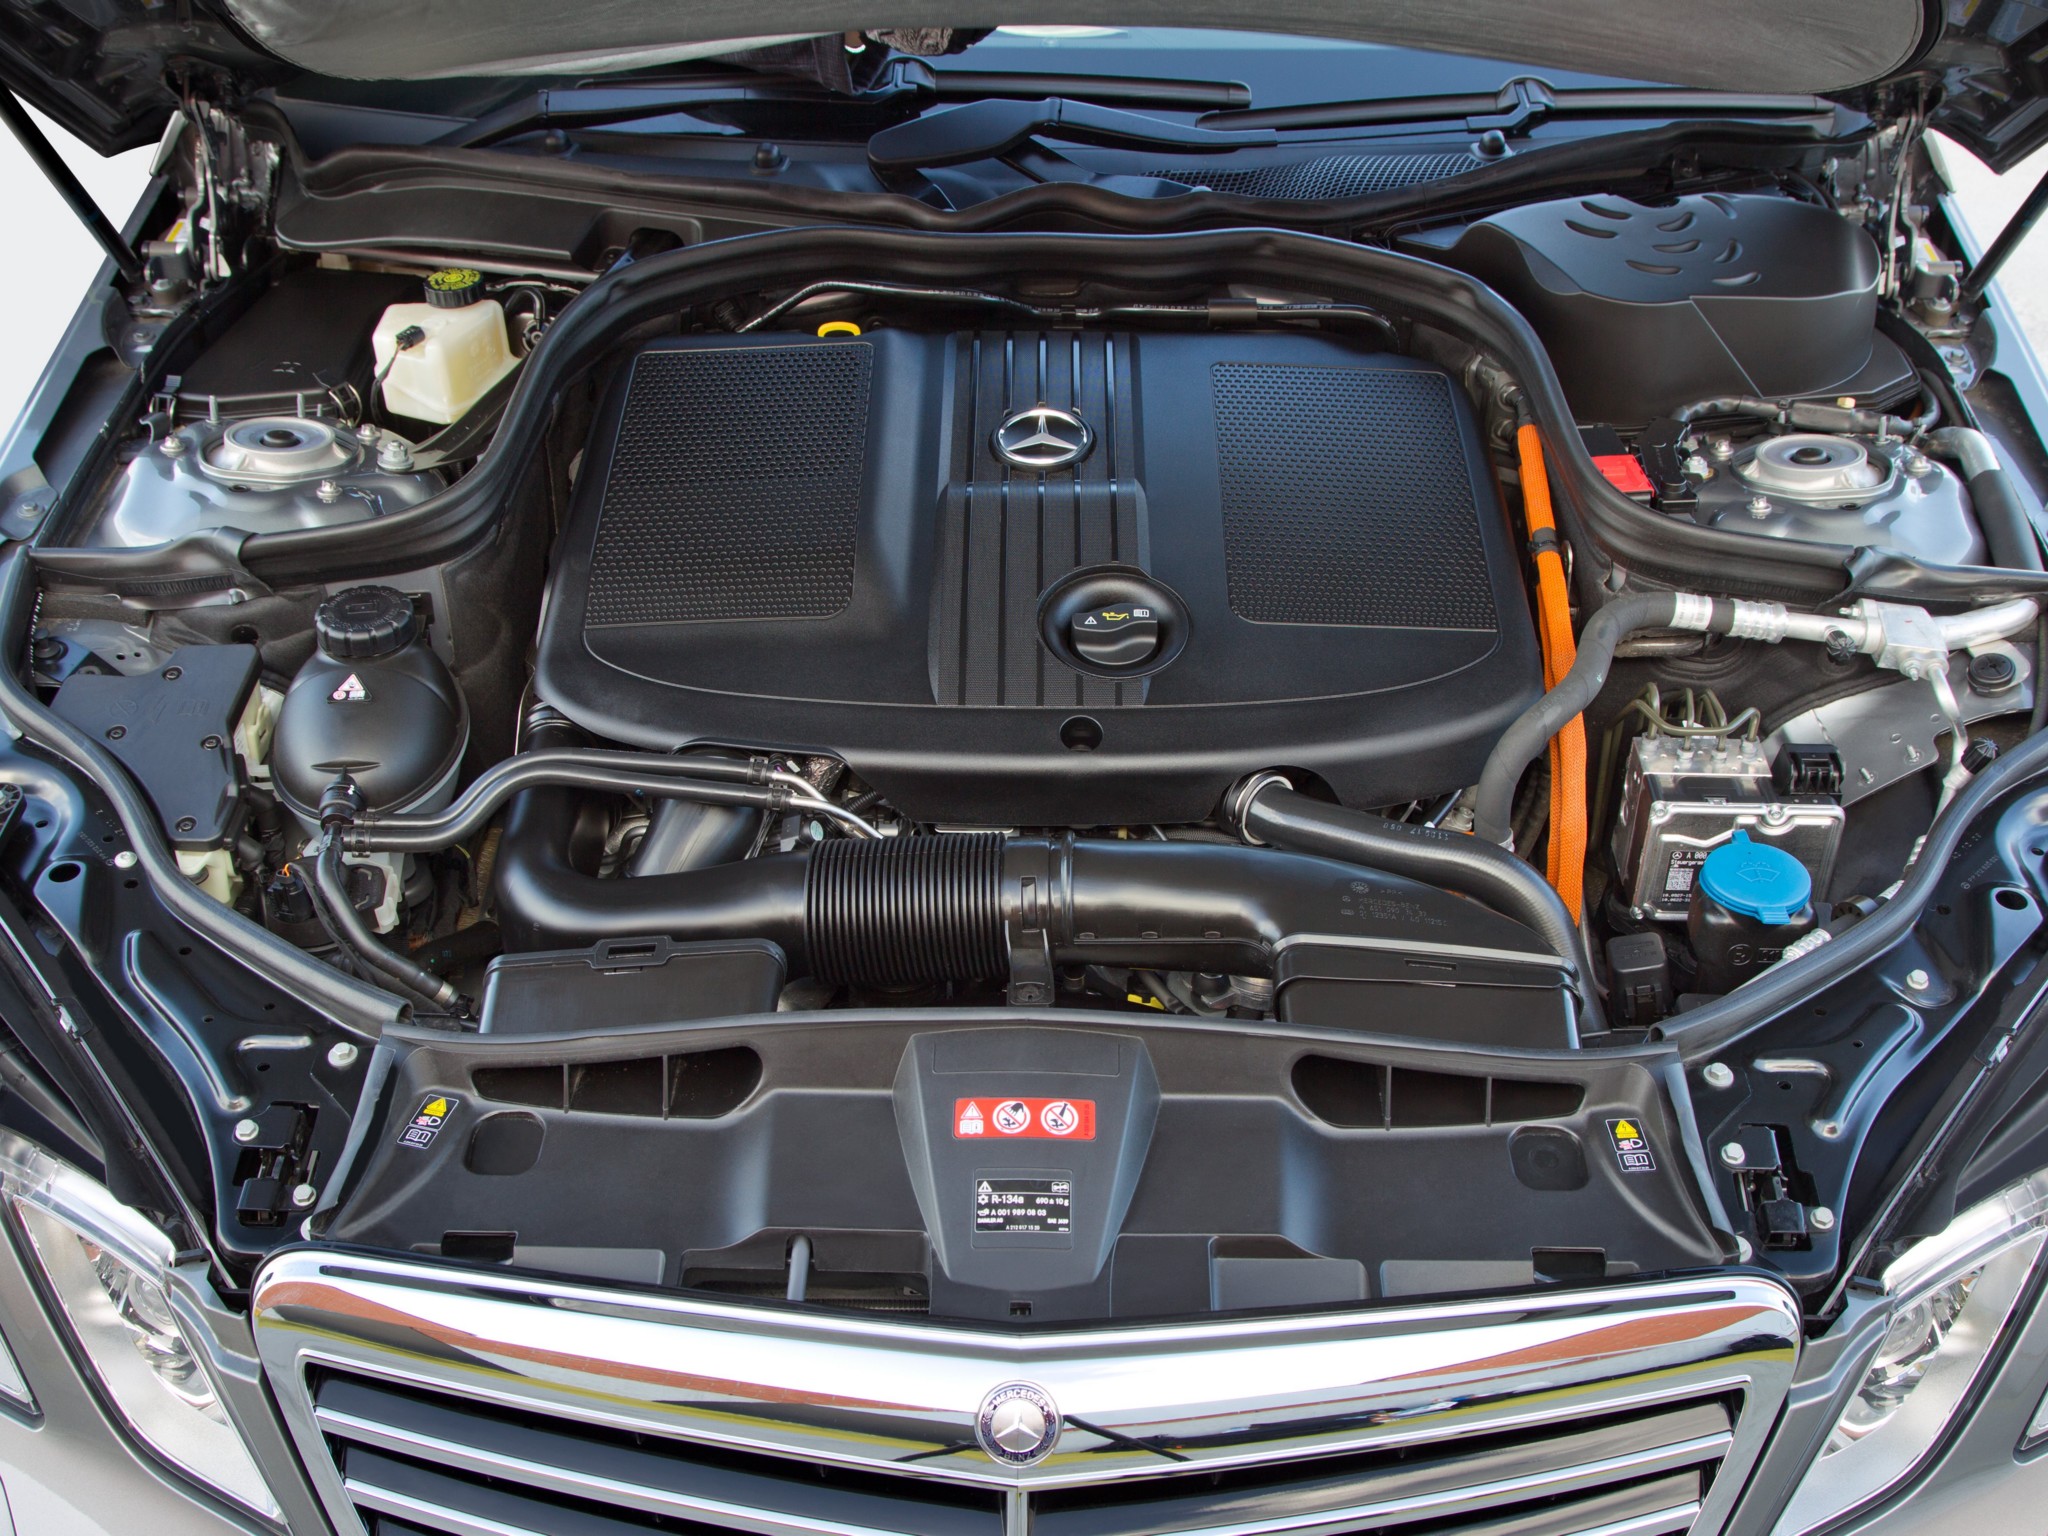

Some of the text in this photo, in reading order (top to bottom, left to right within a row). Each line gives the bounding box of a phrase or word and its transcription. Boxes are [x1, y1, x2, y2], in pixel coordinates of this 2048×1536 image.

[991, 1195, 1024, 1204] R-134a
[990, 1208, 997, 1216] A
[997, 1208, 1011, 1216] 001
[992, 1389, 1046, 1407] MERCEDES
